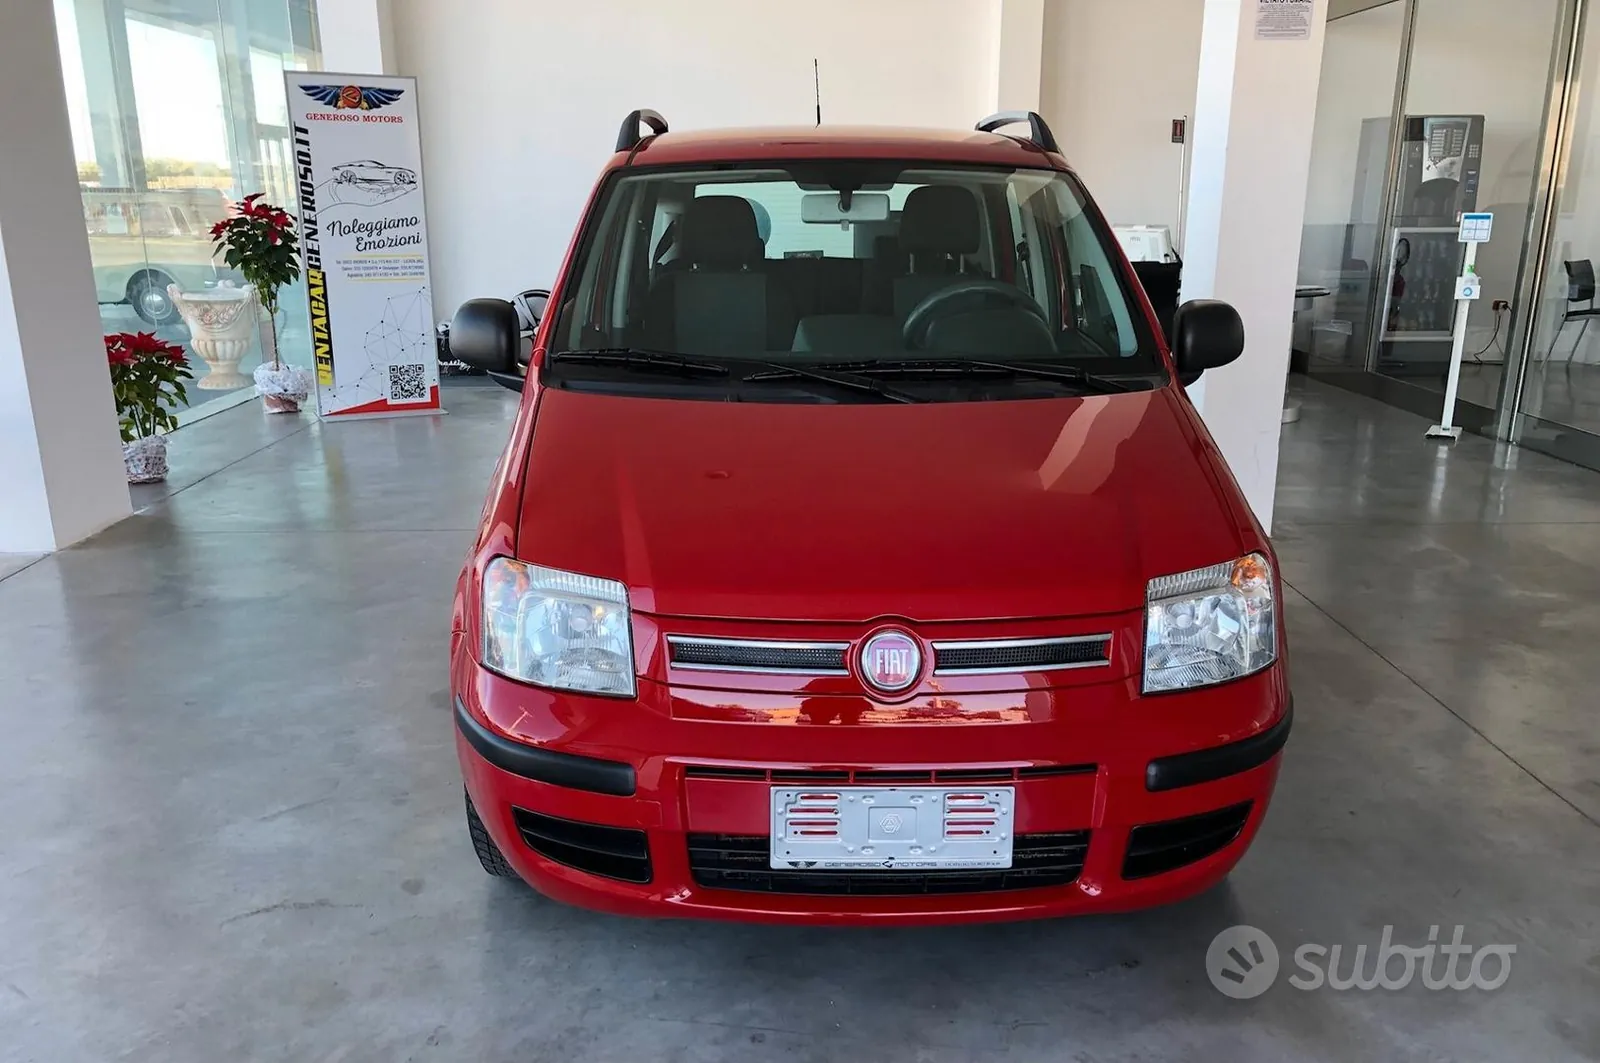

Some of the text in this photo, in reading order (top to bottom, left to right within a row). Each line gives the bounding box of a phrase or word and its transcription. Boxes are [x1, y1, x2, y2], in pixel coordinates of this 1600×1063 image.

[305, 113, 404, 124] GENEROSO MOTORS
[326, 216, 419, 238] Noleggiamo
[355, 232, 422, 252] Emozioni
[875, 648, 909, 675] FIAT
